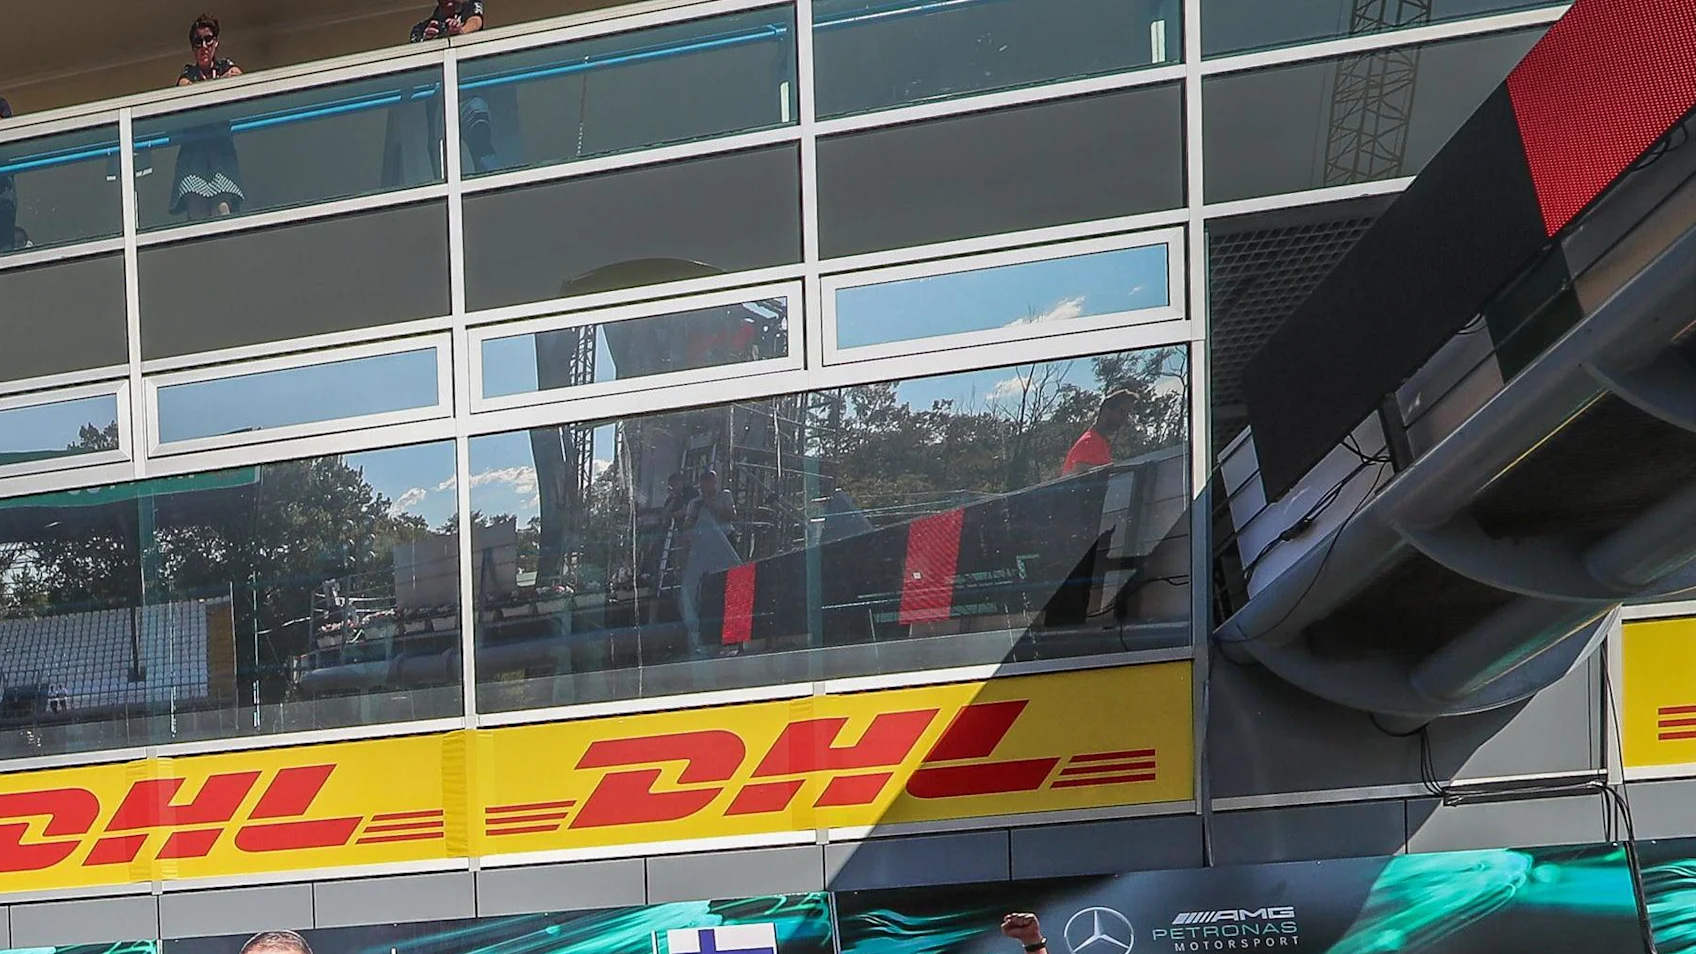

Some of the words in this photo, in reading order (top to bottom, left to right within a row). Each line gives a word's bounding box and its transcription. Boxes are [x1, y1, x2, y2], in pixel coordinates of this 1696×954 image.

[573, 700, 1059, 829] DHL
[1217, 906, 1295, 921] AMG
[1152, 921, 1299, 941] PETRONAS
[1174, 936, 1300, 952] MOTORSPORT
